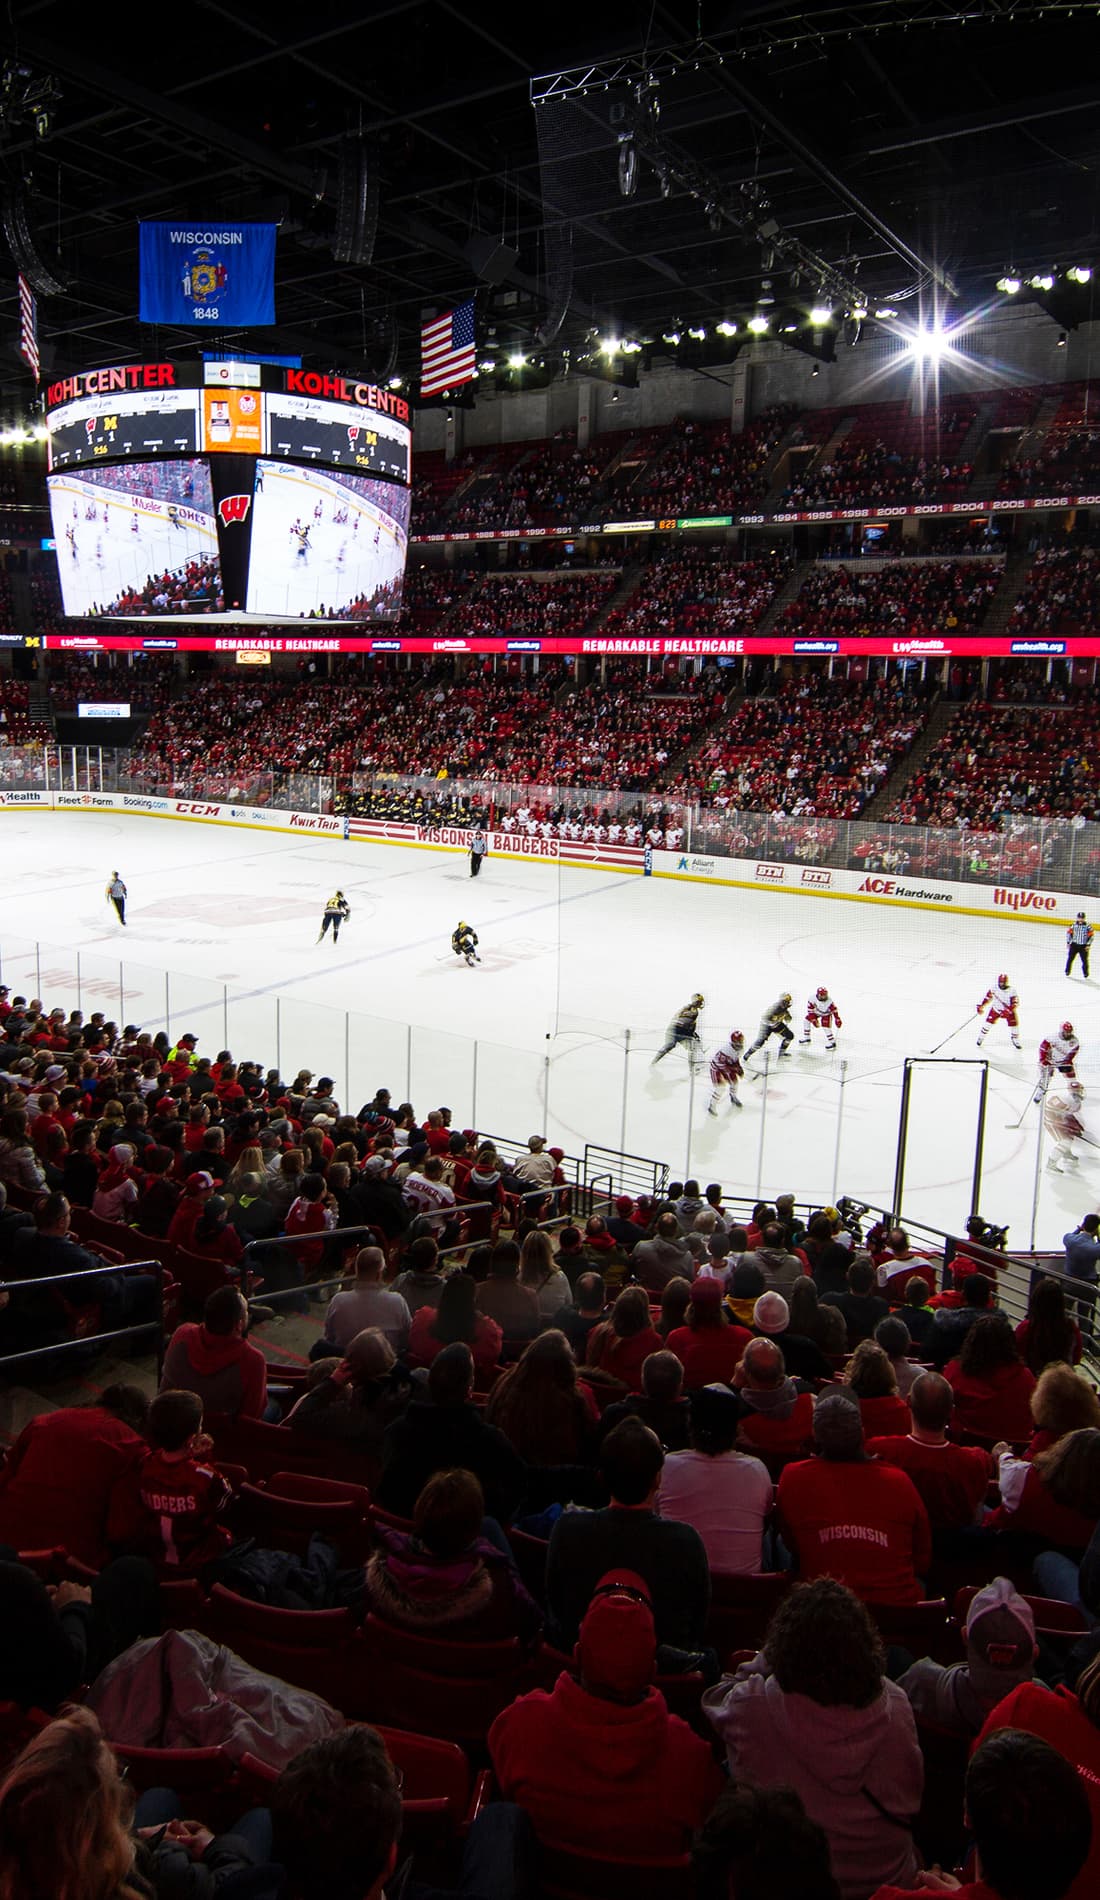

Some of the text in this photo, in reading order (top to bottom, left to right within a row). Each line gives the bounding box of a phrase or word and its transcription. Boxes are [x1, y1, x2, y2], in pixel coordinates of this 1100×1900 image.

[170, 232, 242, 244] WISCONSIN
[192, 308, 219, 319] 1848
[48, 364, 175, 406] KOHL CENTER
[287, 369, 352, 401] KOHL
[354, 383, 409, 423] CENTER
[952, 502, 985, 511] 2004
[993, 500, 1026, 509] 2005
[1034, 497, 1069, 507] 2006
[841, 509, 869, 518] 1998
[877, 506, 907, 516] 2000
[913, 504, 944, 514] 2001
[739, 515, 764, 524] 1993
[772, 513, 798, 522] 1994
[806, 511, 833, 520] 1995
[579, 525, 601, 533] 1992
[215, 639, 340, 650] REMARKABLE HEALTHCARE
[583, 640, 744, 653] REMARKABLE HEALTHCARE
[58, 796, 114, 806] Fleet Farm
[123, 797, 168, 809] Booking.com
[175, 803, 220, 816] CCM
[493, 833, 558, 857] BADGERS
[692, 858, 715, 867] Alliant
[757, 866, 783, 877] BTN
[803, 870, 830, 882] BTN
[857, 877, 953, 902] ACE Hardware
[994, 888, 1057, 911] HyVee
[818, 1524, 888, 1547] WISCONSIN
